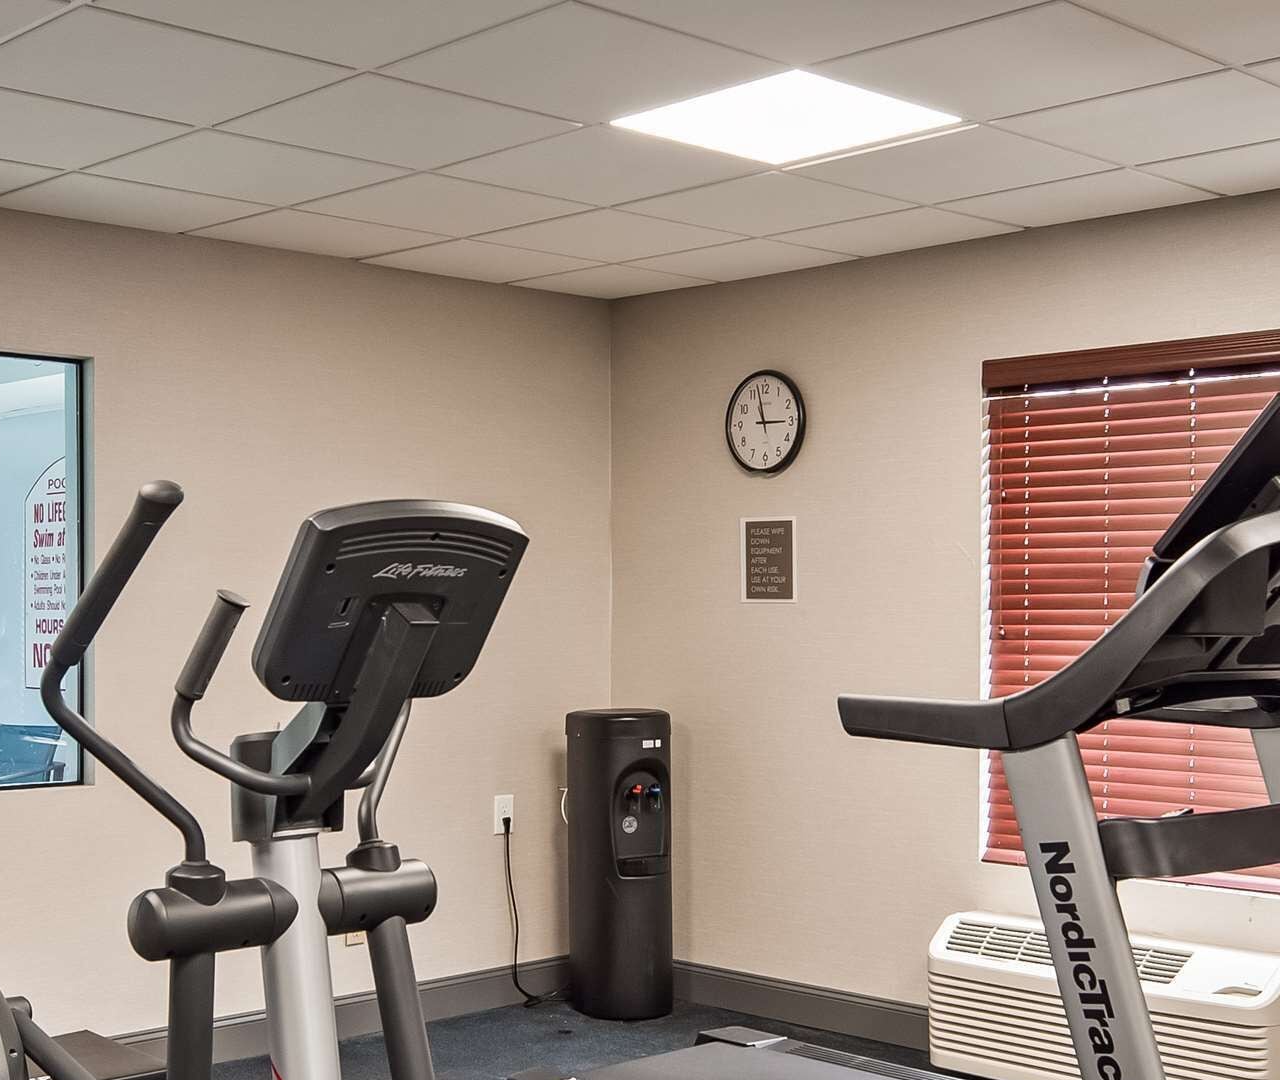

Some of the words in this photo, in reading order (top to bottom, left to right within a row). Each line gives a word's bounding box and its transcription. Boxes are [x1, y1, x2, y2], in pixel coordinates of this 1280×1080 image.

[761, 383, 770, 394] 12
[749, 389, 756, 400] 11
[785, 398, 791, 409] 2
[740, 404, 749, 415] 10
[737, 420, 743, 431] 9
[788, 415, 794, 427] 3
[741, 436, 746, 447] 8
[784, 432, 790, 442] 4
[750, 448, 756, 459] 7
[762, 451, 768, 462] 6
[775, 446, 781, 457] 5
[33, 503, 44, 524] NO
[751, 527, 770, 536] PLEASE
[771, 527, 785, 535] WIPE
[33, 528, 54, 548] Swim
[751, 537, 770, 545] DOWN
[751, 546, 783, 555] EQUIPMENT
[751, 556, 767, 564] AFTER
[372, 563, 413, 579] Life
[406, 563, 468, 579] Fitness
[751, 566, 767, 574] EACH
[771, 575, 786, 584] YOUR
[751, 585, 766, 593] OWN
[35, 618, 64, 634] HOURS
